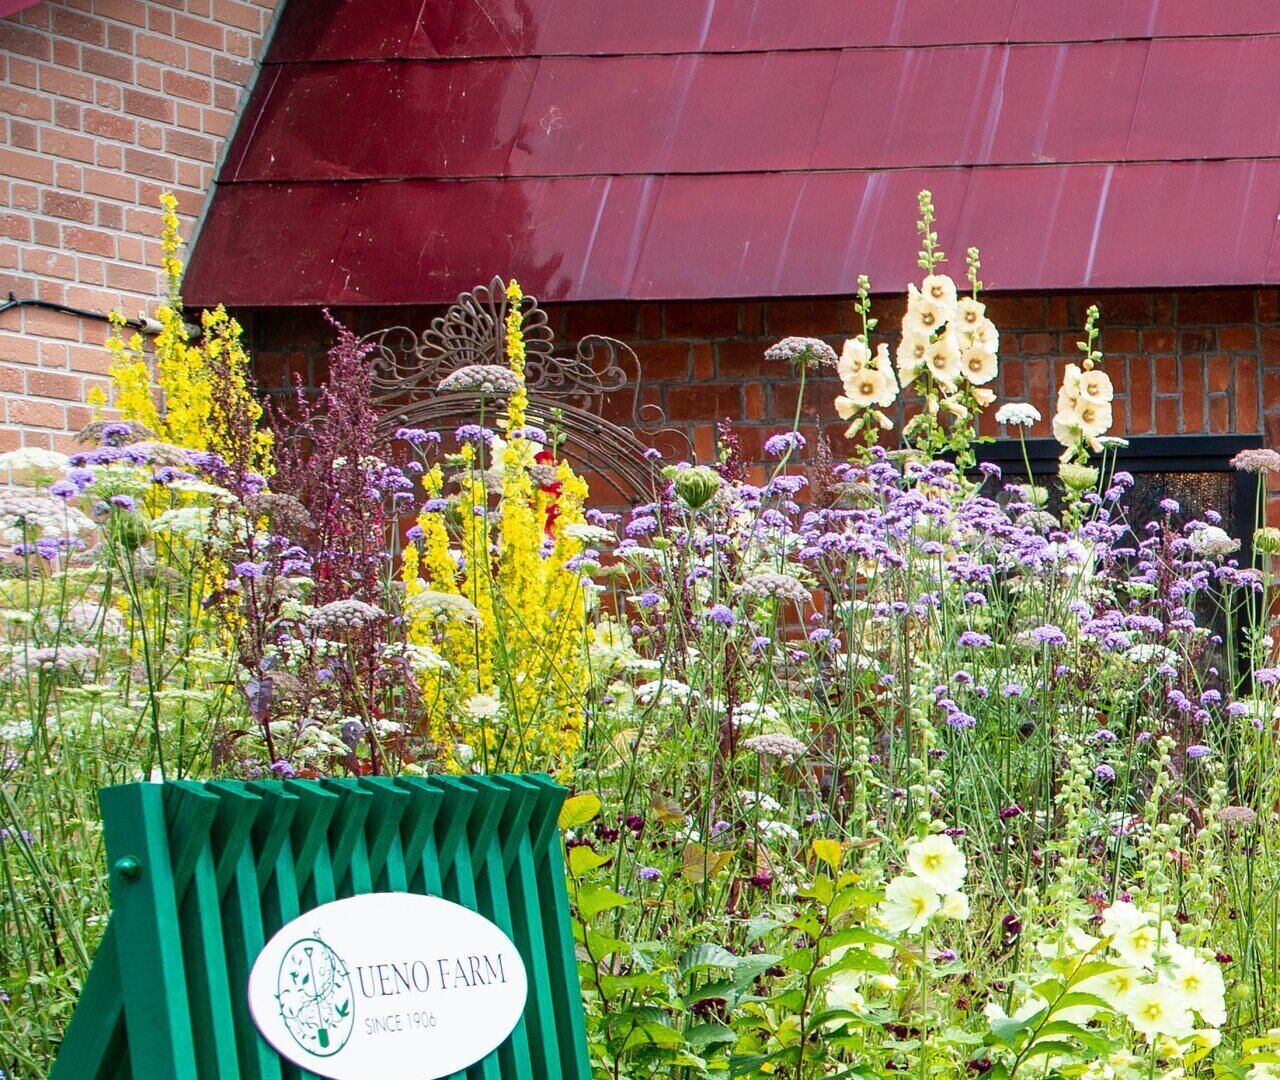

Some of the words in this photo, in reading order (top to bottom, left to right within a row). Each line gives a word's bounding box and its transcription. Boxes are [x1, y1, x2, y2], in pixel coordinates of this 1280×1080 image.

[356, 960, 430, 998] UENO
[438, 953, 508, 990] FARM
[365, 1014, 403, 1035] SINCE
[407, 1012, 437, 1031] 1906
